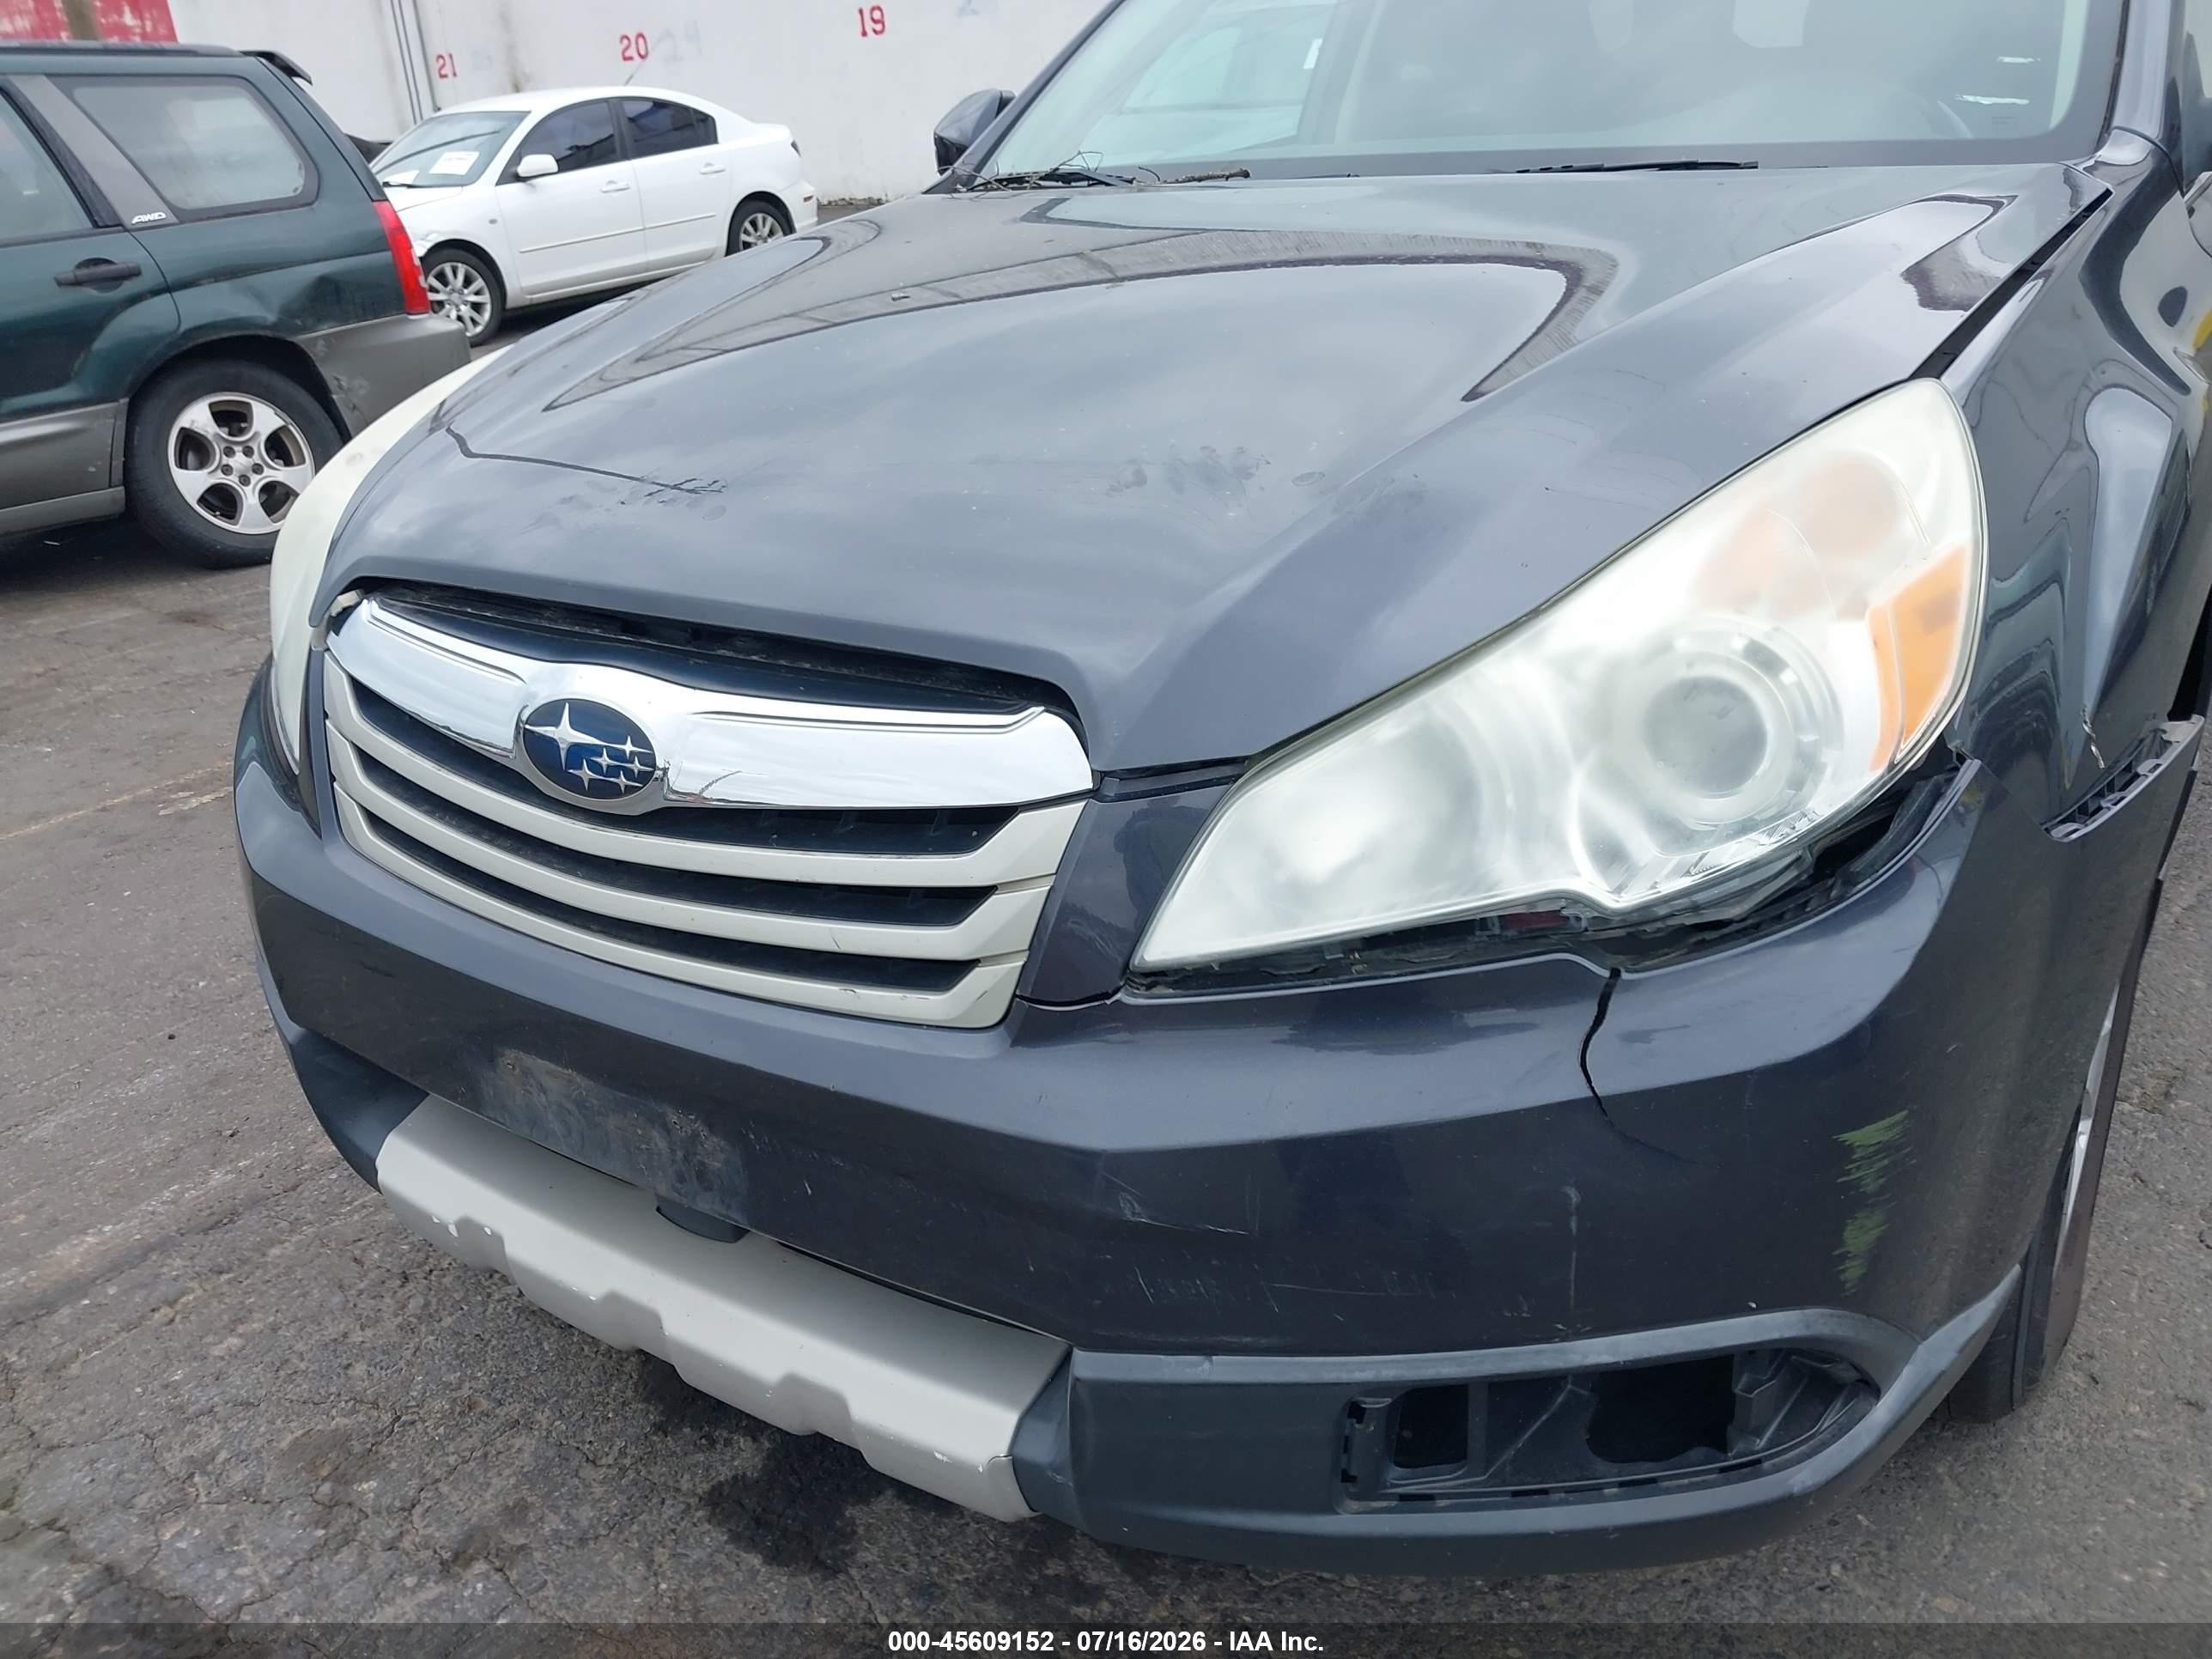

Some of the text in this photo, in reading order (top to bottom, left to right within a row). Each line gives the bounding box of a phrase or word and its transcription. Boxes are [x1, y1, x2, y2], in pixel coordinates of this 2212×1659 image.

[858, 4, 886, 37] 19
[619, 31, 649, 62] 20
[435, 52, 458, 79] 21
[131, 211, 167, 224] AWD
